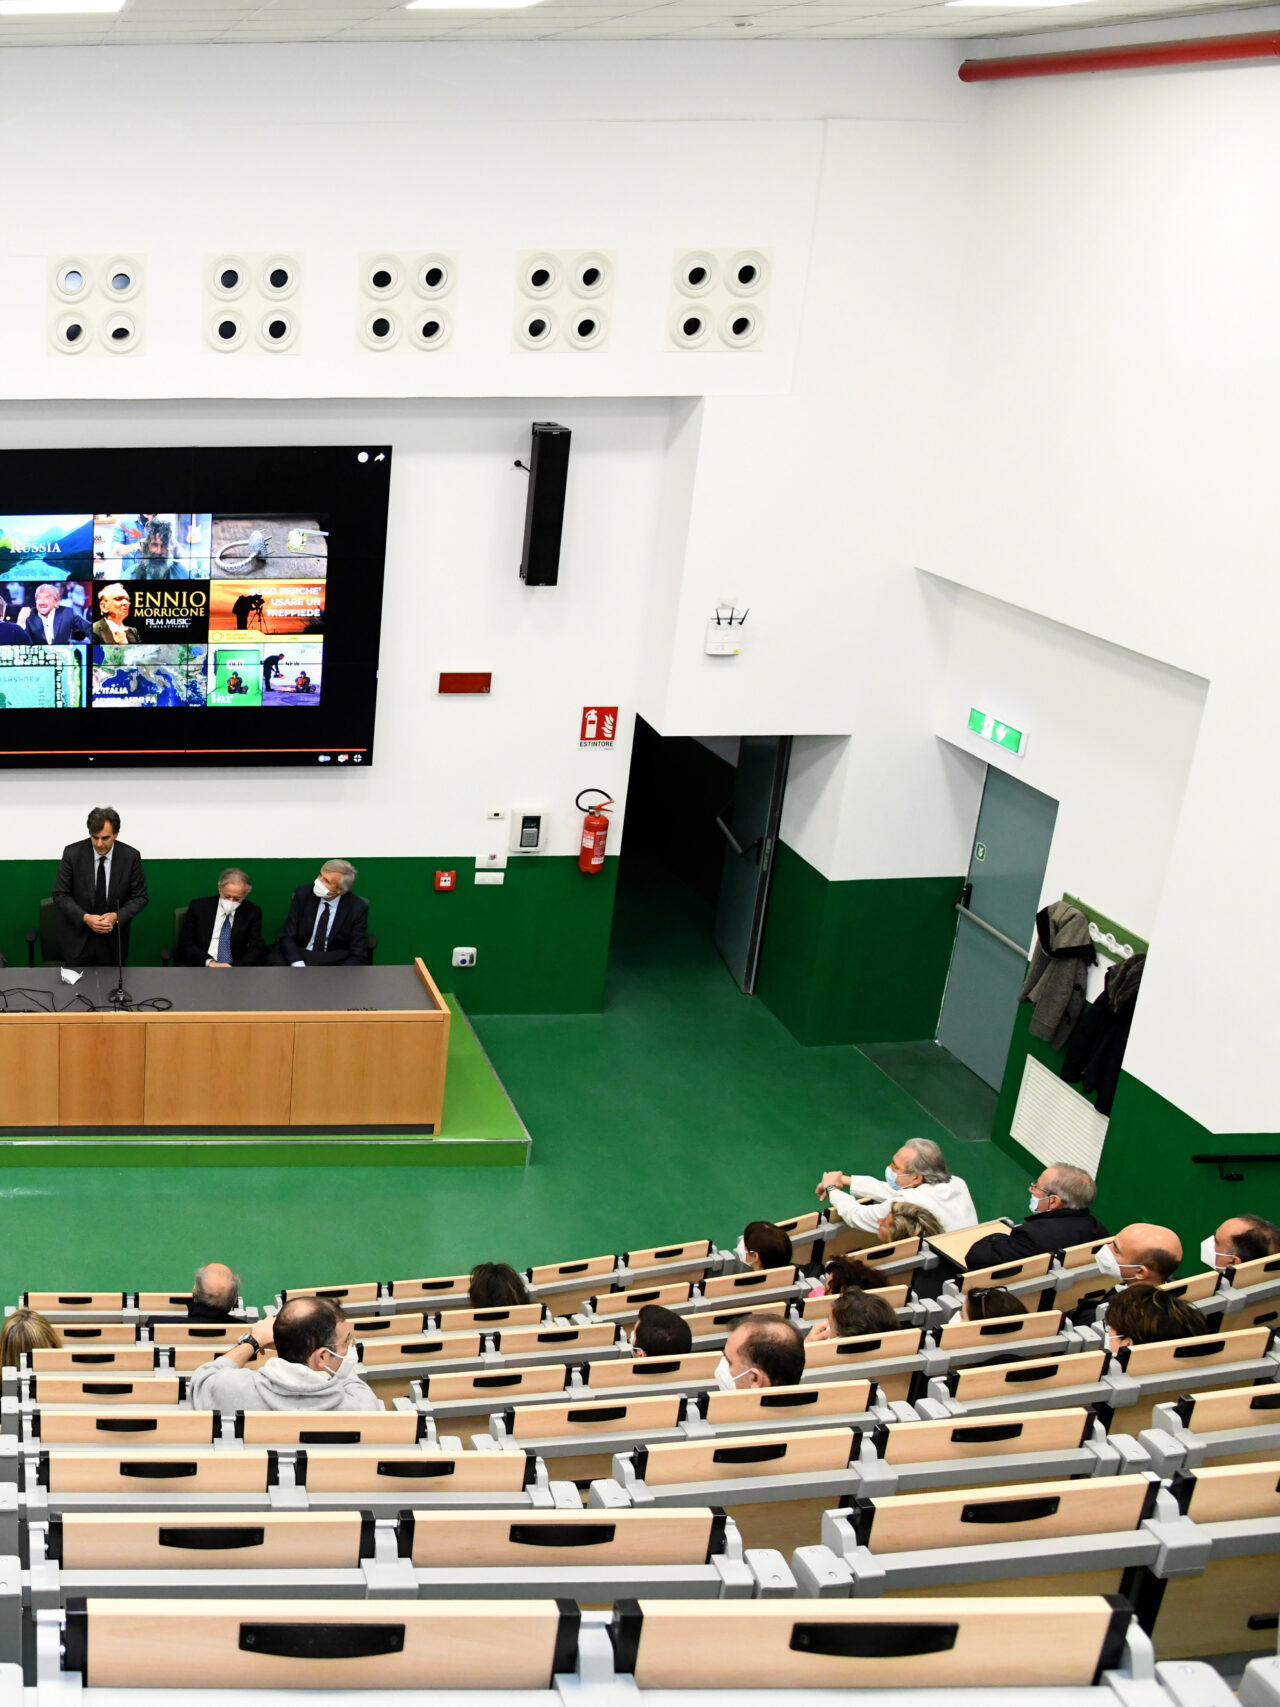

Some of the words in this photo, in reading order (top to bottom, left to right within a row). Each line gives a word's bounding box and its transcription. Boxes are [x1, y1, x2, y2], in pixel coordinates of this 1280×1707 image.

[10, 539, 62, 554] RUSSIA
[134, 590, 207, 608] ENNIO
[271, 598, 304, 606] USARE
[306, 597, 321, 605] UN
[134, 607, 205, 617] MORRICONE
[266, 608, 321, 617] TREPPIEDE
